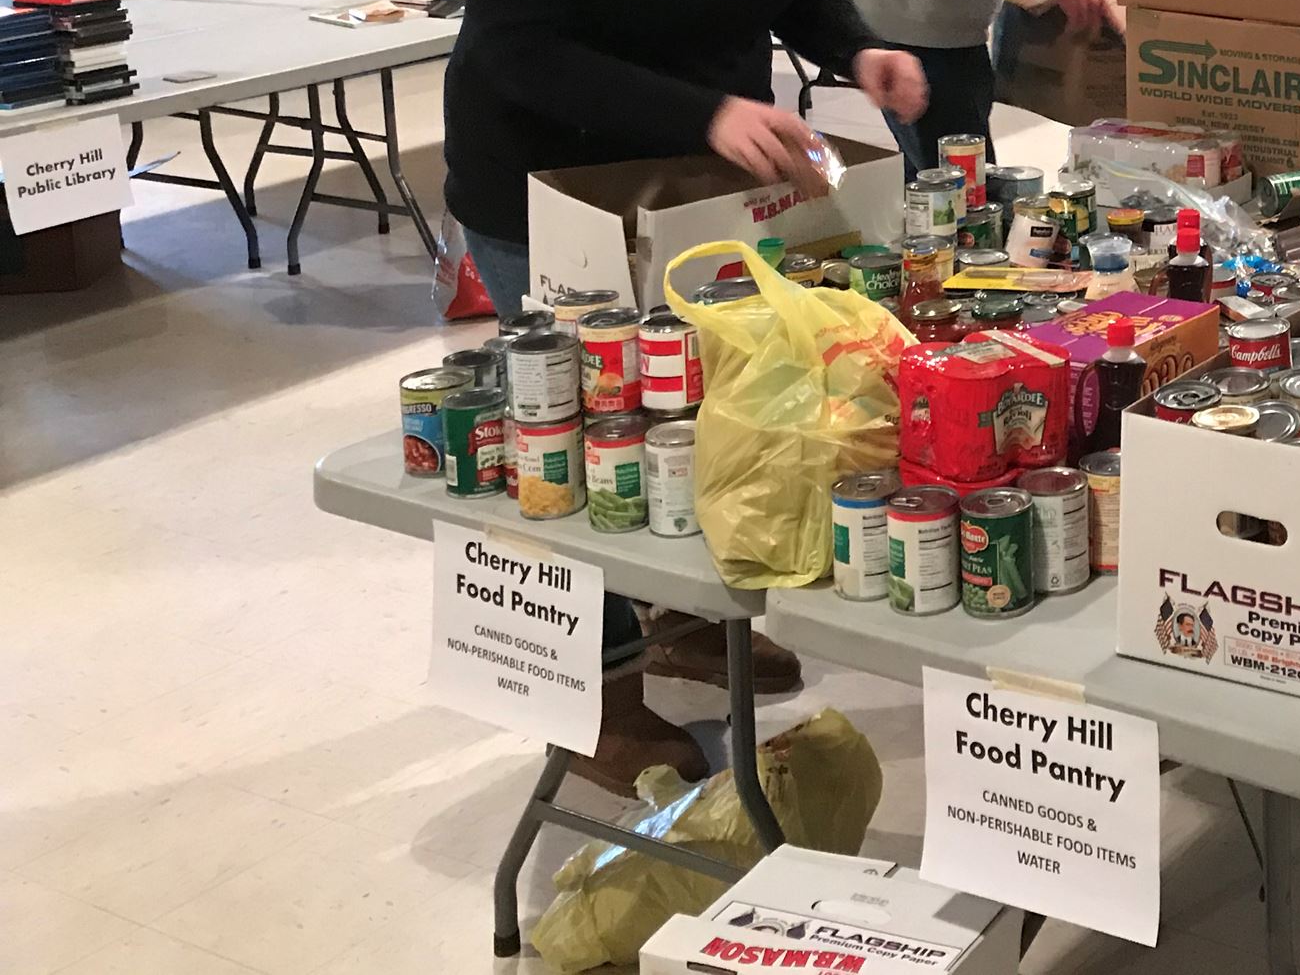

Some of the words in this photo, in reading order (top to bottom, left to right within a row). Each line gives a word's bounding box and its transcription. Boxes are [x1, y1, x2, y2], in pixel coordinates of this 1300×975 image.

[1219, 49, 1253, 59] MOVING
[1255, 53, 1261, 61] &
[1140, 86, 1192, 102] WORLD
[1196, 94, 1233, 106] WIDE
[26, 157, 75, 177] Cherry
[79, 147, 103, 166] Hill
[17, 180, 62, 199] Public
[65, 167, 116, 187] Library
[1230, 340, 1282, 363] Campbell's
[465, 541, 532, 584] Cherry
[538, 562, 572, 593] Hill
[456, 573, 504, 607] Food
[511, 591, 580, 636] Pantry
[474, 624, 513, 646] CANNED
[515, 637, 548, 658] GOODS
[550, 648, 558, 661] &
[1236, 622, 1283, 646] Copy
[447, 637, 525, 673] NON-PERISHABLE
[528, 663, 555, 682] FOOD
[557, 673, 586, 693] ITEMS
[497, 676, 530, 696] WATER
[965, 692, 1058, 743] Cherry
[1067, 715, 1113, 751] Hill
[955, 730, 1021, 770] Food
[1031, 749, 1126, 803] Pantry
[982, 789, 1034, 814] CANNED
[1037, 805, 1083, 829] GOODS
[1087, 817, 1098, 832] &
[947, 805, 1053, 846] NON-PERISHABLE
[1056, 835, 1093, 857] FOOD
[1096, 847, 1137, 870] ITEMS
[1017, 850, 1061, 874] WATER
[701, 936, 867, 974] W.B.MASON
[809, 934, 864, 951] Premium
[867, 946, 899, 959] Copy
[900, 953, 939, 966] Paper
[815, 926, 947, 958] FLAGSHIP
